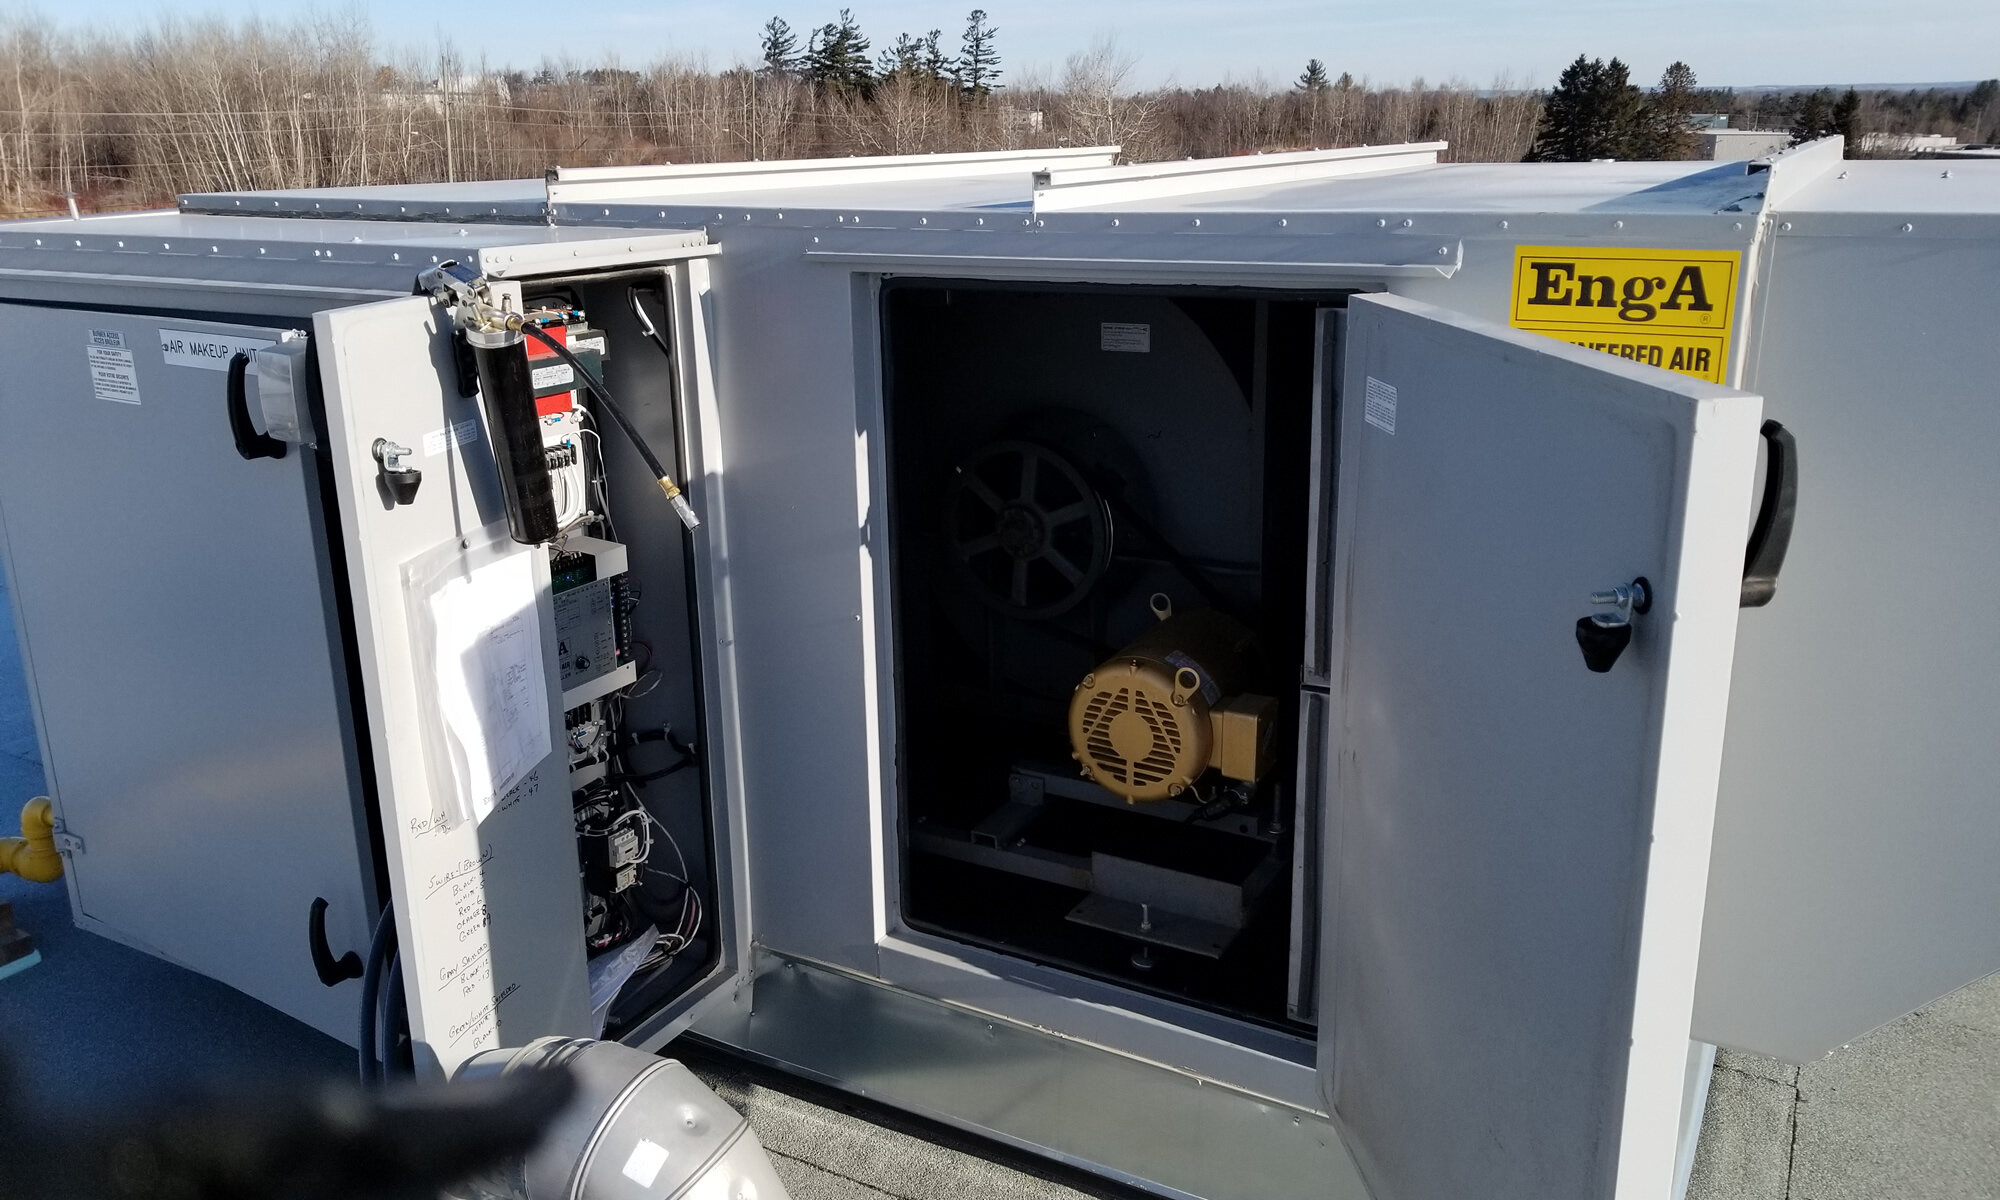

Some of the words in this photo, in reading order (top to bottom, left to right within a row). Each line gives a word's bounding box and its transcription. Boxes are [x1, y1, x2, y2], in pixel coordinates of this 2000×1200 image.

[1527, 261, 1713, 322] EngA
[170, 340, 185, 354] AIR
[189, 342, 229, 359] MAKEUP
[1669, 346, 1712, 372] AIR
